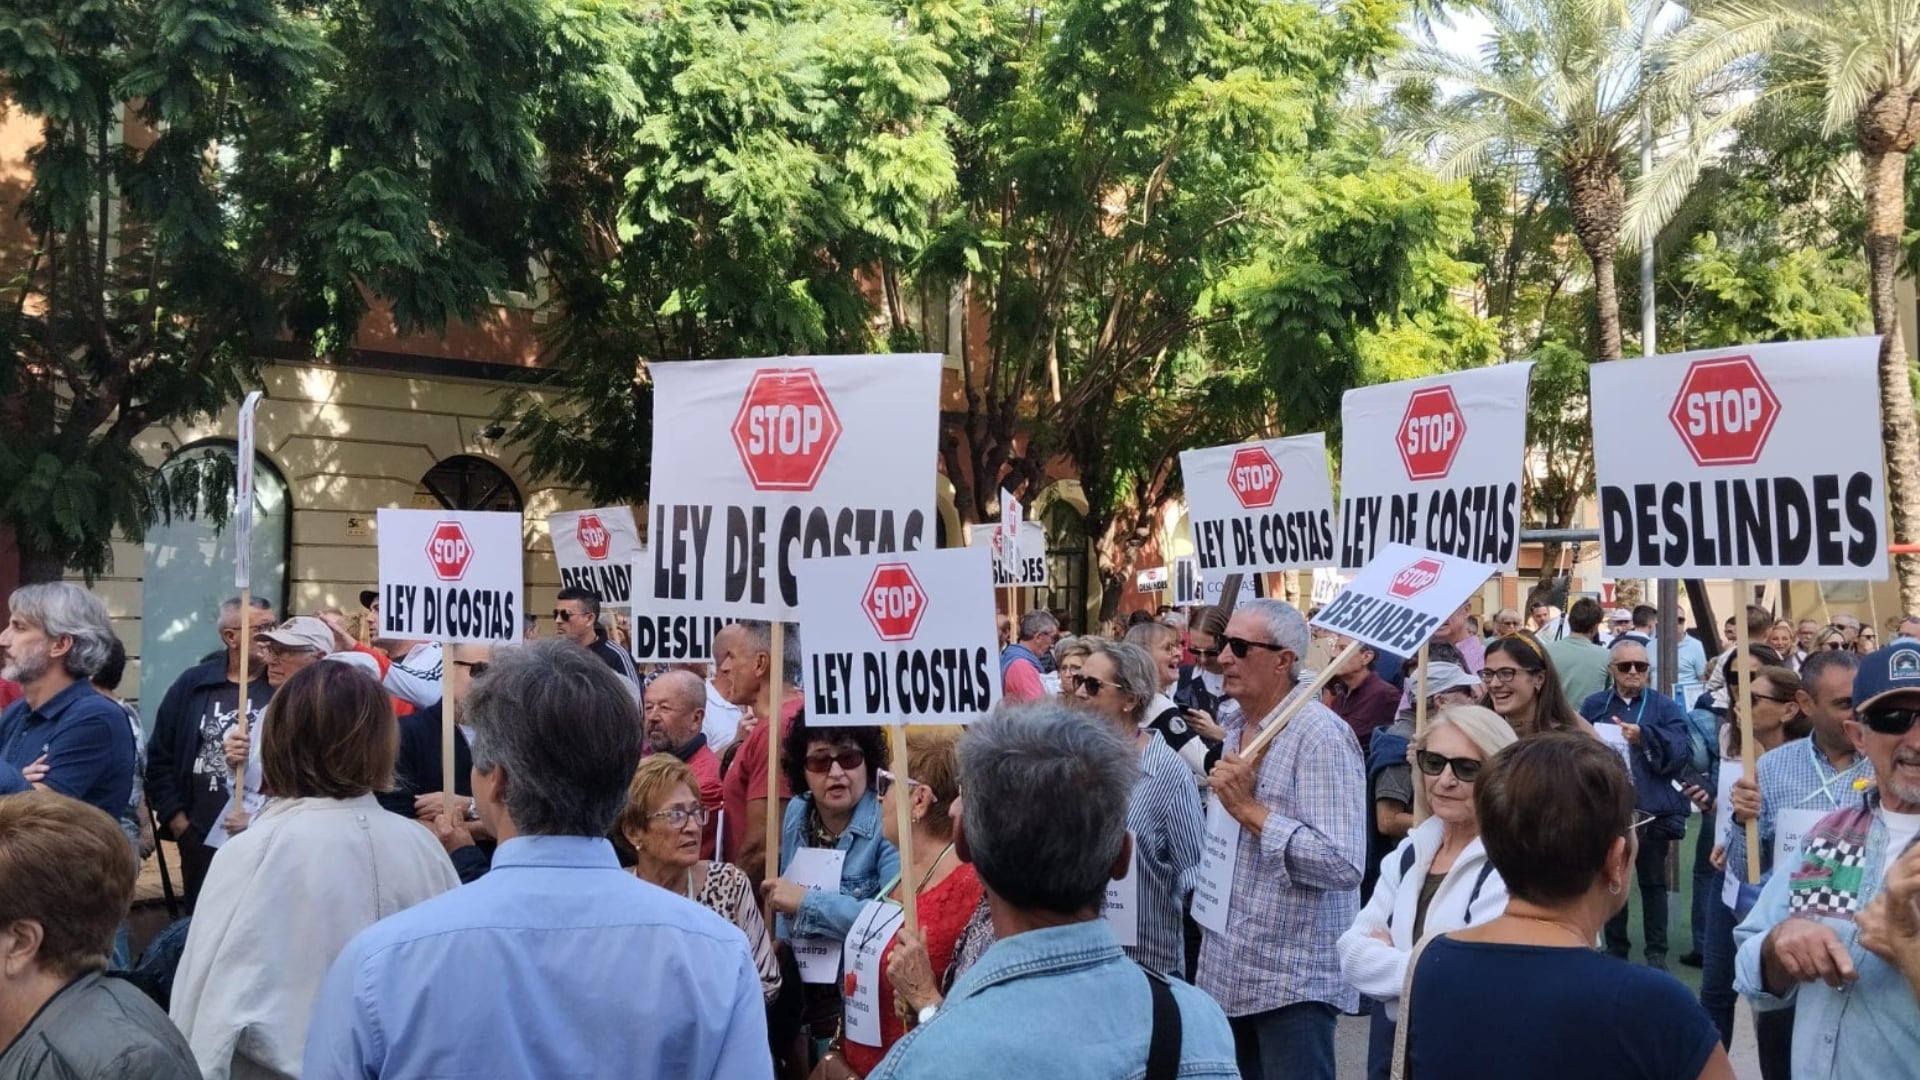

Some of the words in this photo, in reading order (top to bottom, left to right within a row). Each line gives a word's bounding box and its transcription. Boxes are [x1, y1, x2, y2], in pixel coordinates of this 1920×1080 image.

[749, 404, 822, 455] STOP
[1407, 412, 1455, 456] STOP
[1687, 387, 1762, 437] STOP
[1236, 463, 1274, 493] STOP
[1195, 519, 1226, 568] LEY
[1232, 516, 1257, 566] DE
[1260, 508, 1333, 565] COSTAS
[1341, 495, 1383, 568] LEY
[1389, 492, 1419, 546] DE
[1426, 482, 1517, 565] COSTAS
[1601, 471, 1877, 567] DESLINDES
[654, 504, 713, 601] LEY
[725, 505, 766, 604] DE
[1397, 567, 1435, 590] STOP
[386, 583, 417, 633] LEY
[446, 587, 514, 641] COSTAS
[1318, 590, 1440, 651] DESLINDES
[812, 651, 853, 715] LEY
[896, 646, 991, 715] COSTAS
